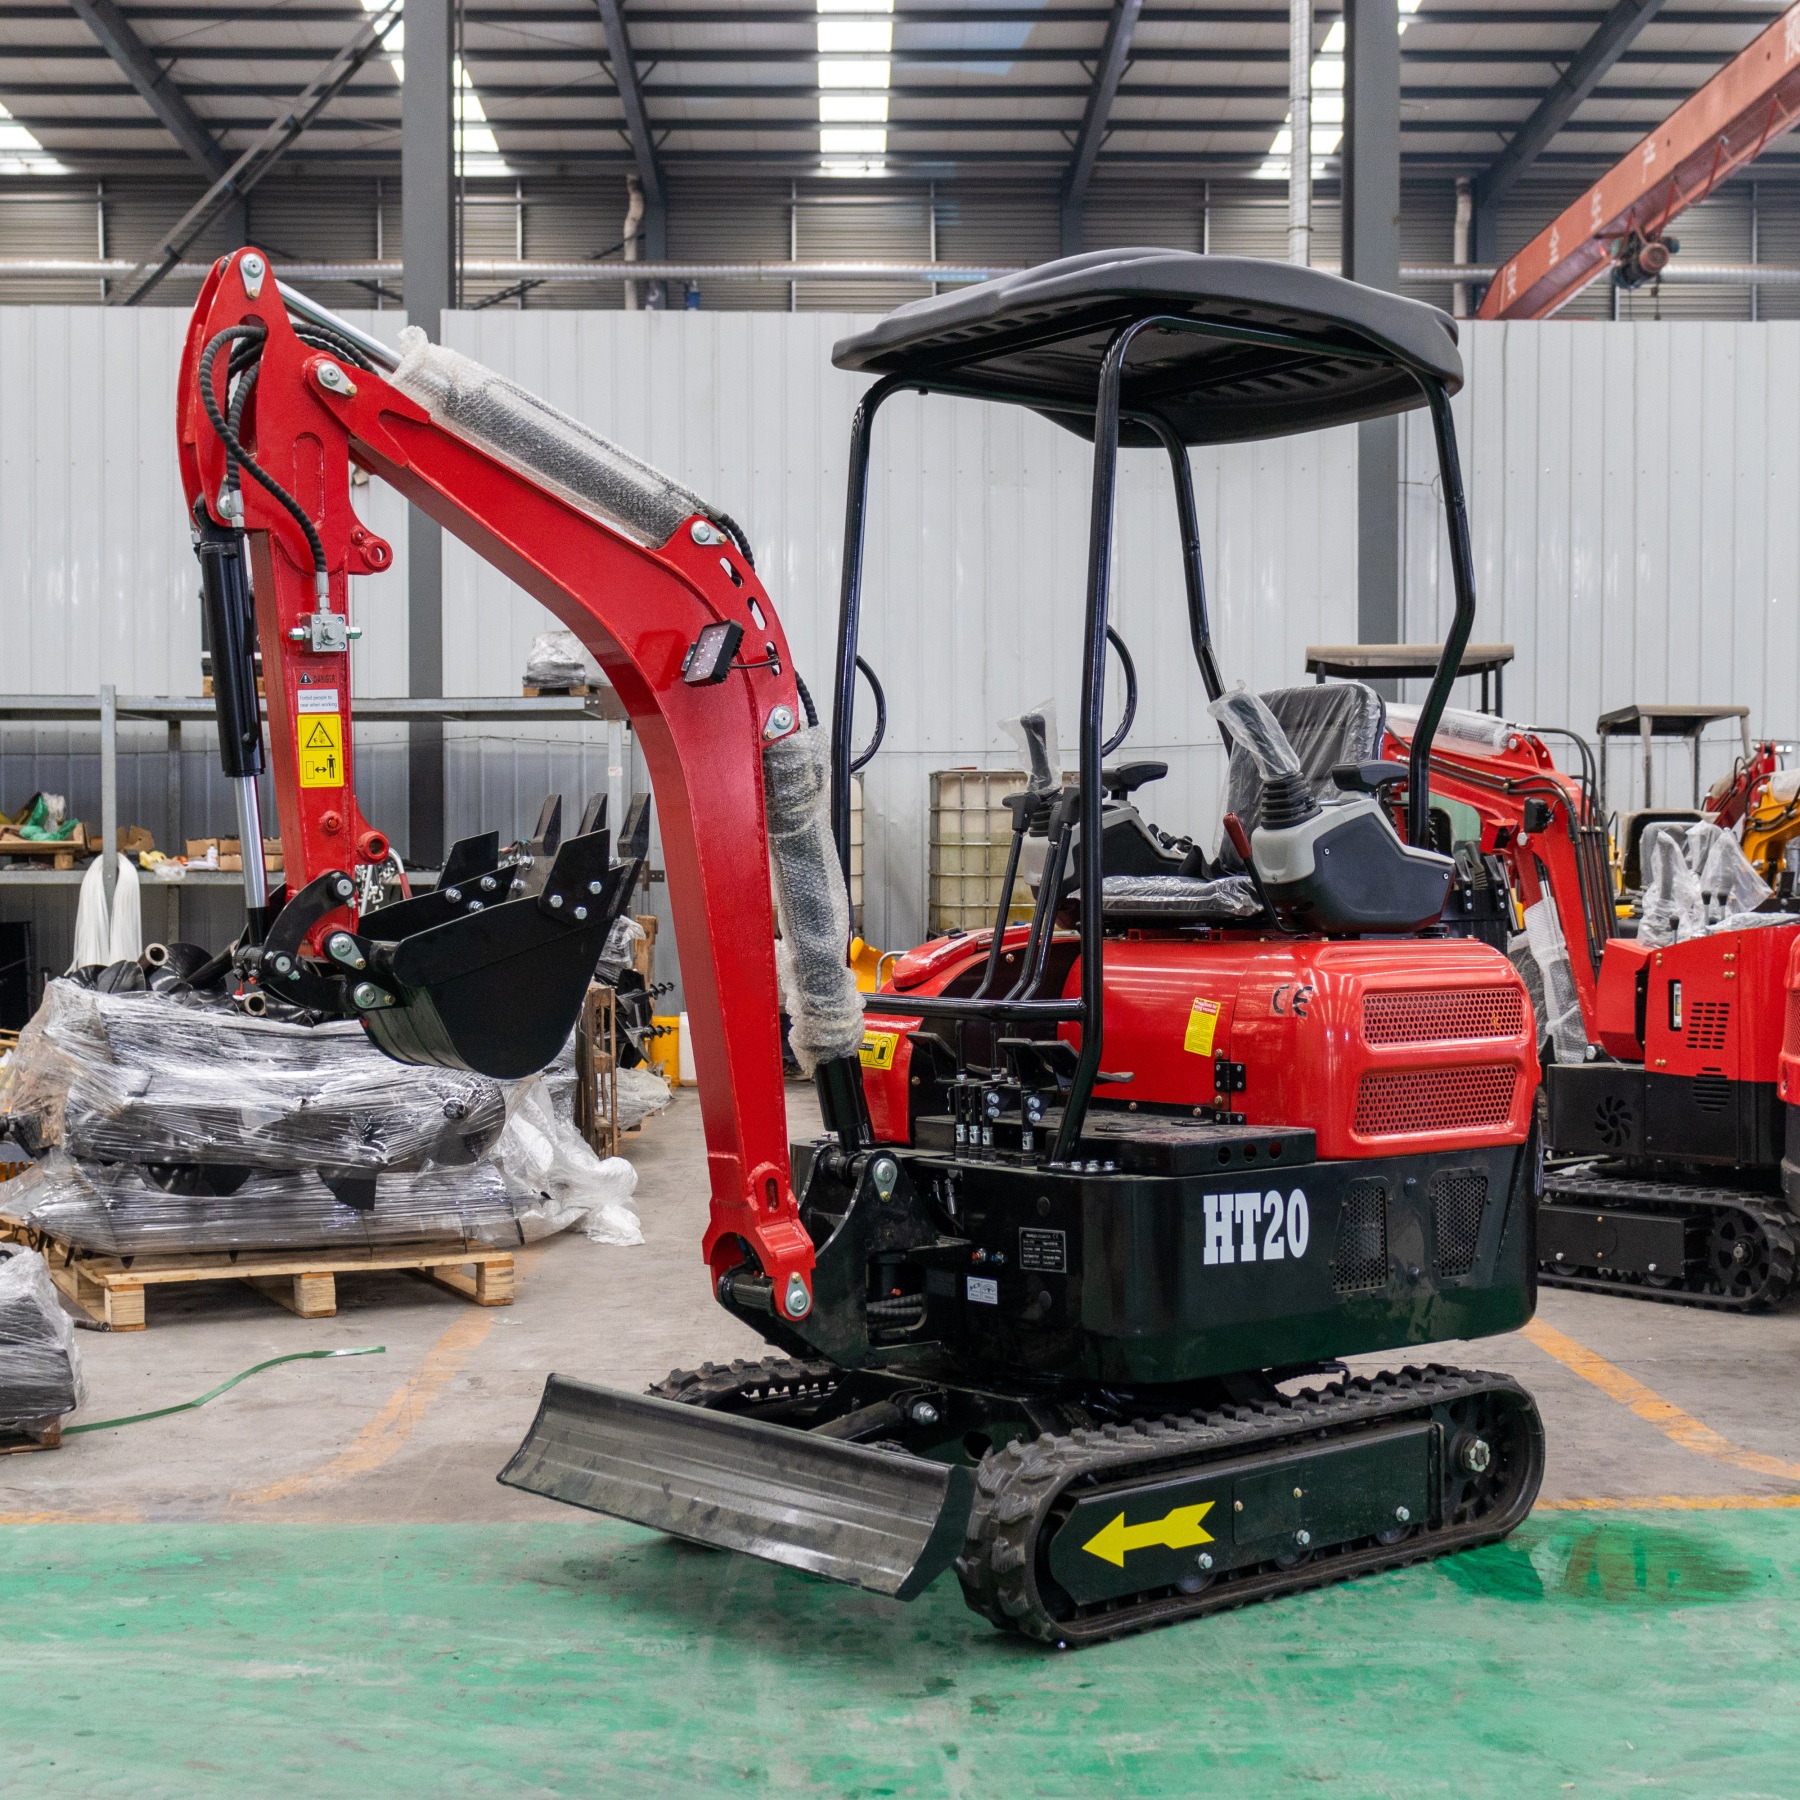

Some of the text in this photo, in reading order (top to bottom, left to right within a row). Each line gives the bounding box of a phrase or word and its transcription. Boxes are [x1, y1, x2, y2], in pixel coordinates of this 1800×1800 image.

[313, 674, 336, 684] DANGER
[1272, 984, 1314, 1018] CE
[1203, 1188, 1310, 1265] HT20
